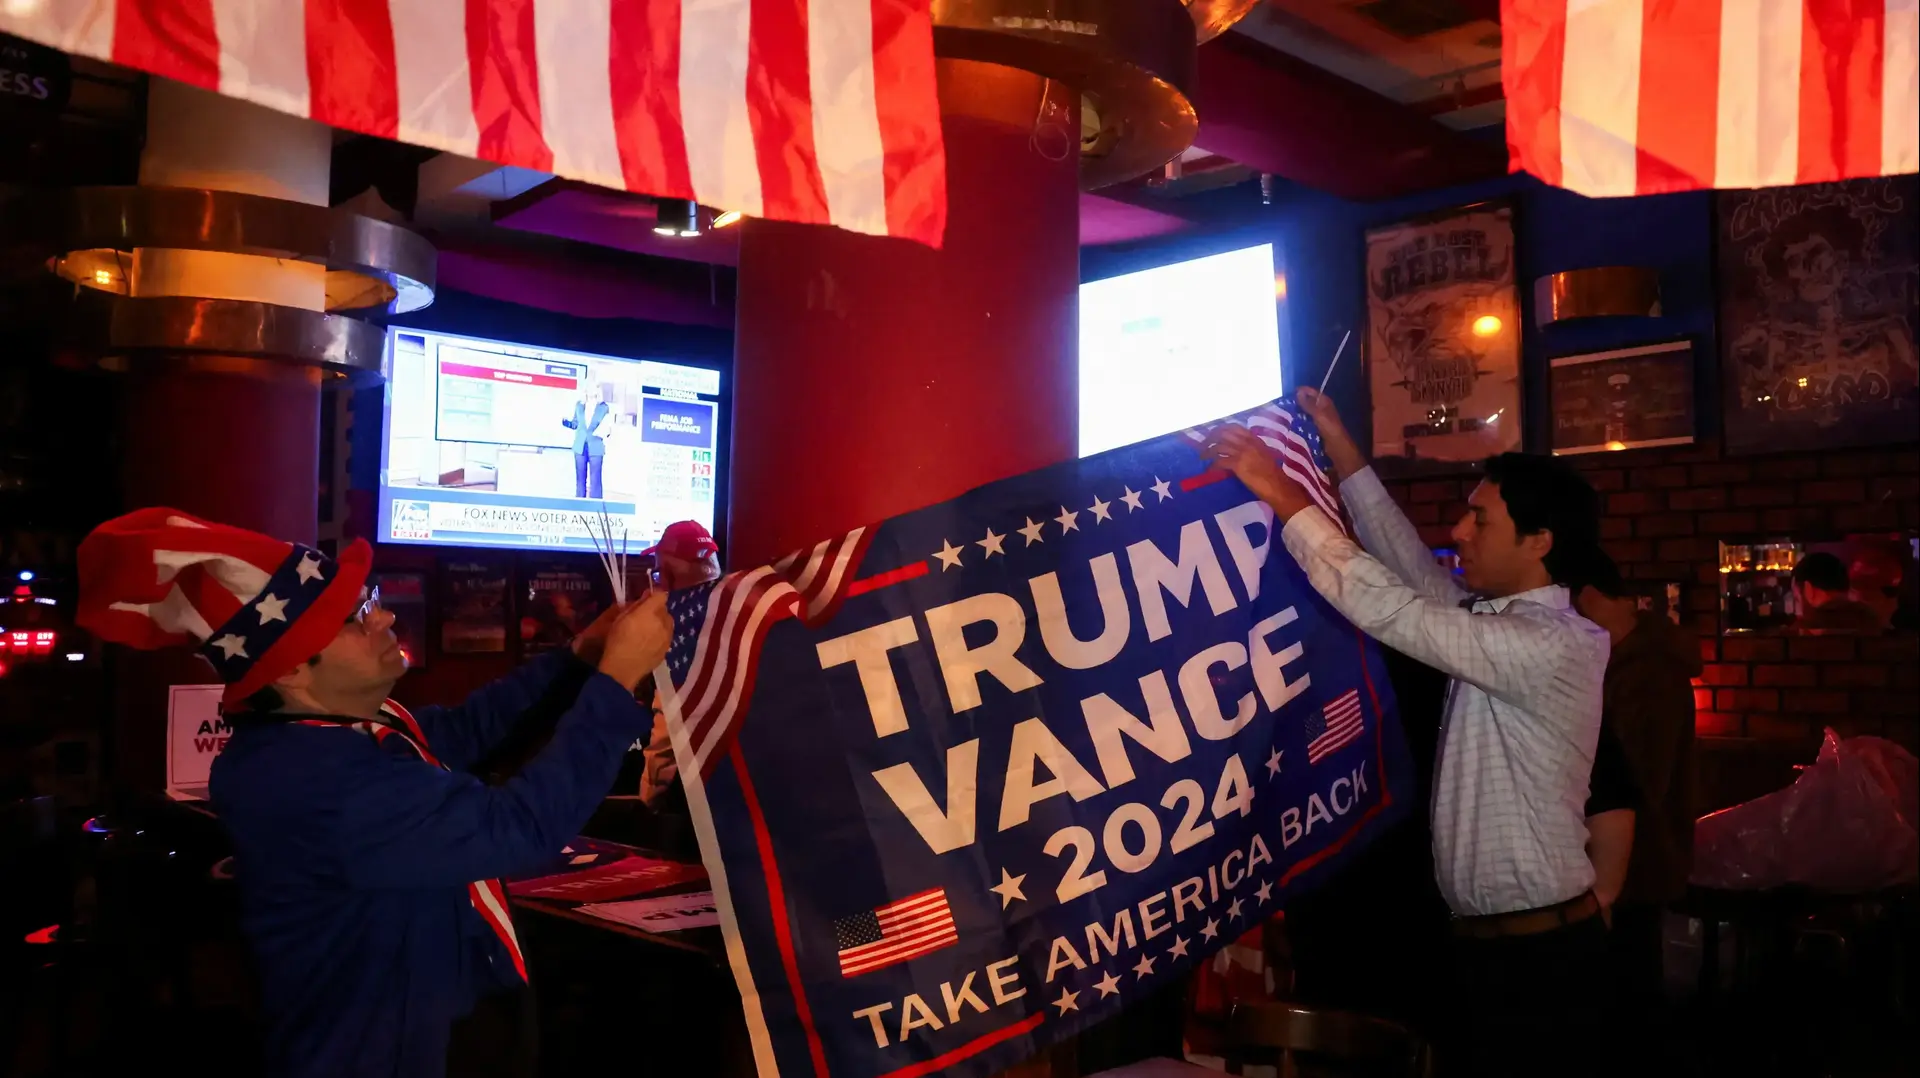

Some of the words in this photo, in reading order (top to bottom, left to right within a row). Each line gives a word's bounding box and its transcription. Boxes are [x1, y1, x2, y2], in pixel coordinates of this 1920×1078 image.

[1381, 247, 1495, 302] REBEL
[651, 422, 701, 434] PERFORMANCE
[464, 508, 489, 521] FOX
[493, 508, 528, 522] NEWS
[531, 511, 568, 525] VOTER
[815, 500, 1278, 739] TRUMP
[871, 605, 1312, 856] VANCE
[1043, 753, 1255, 904] 2024
[853, 955, 1028, 1049] TAKE
[1044, 833, 1273, 984] AMERICA
[1281, 760, 1370, 850] BACK
